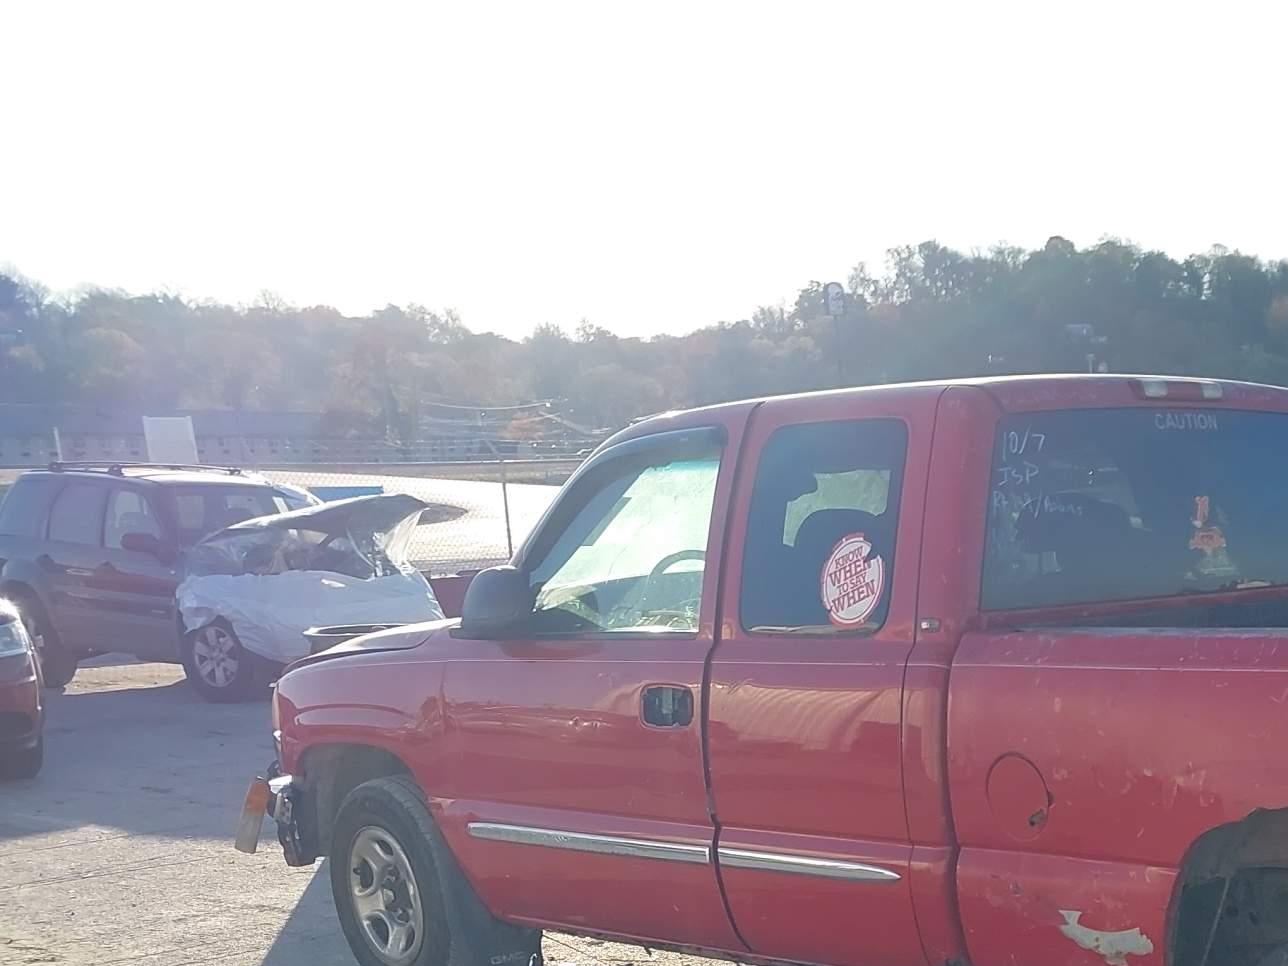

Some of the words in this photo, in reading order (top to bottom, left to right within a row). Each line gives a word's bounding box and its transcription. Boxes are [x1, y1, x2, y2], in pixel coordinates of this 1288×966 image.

[1154, 413, 1218, 430] CAUTION
[835, 545, 864, 569] KNOW
[838, 582, 849, 595] TO
[850, 572, 867, 590] SAY
[832, 579, 876, 613] WHEN
